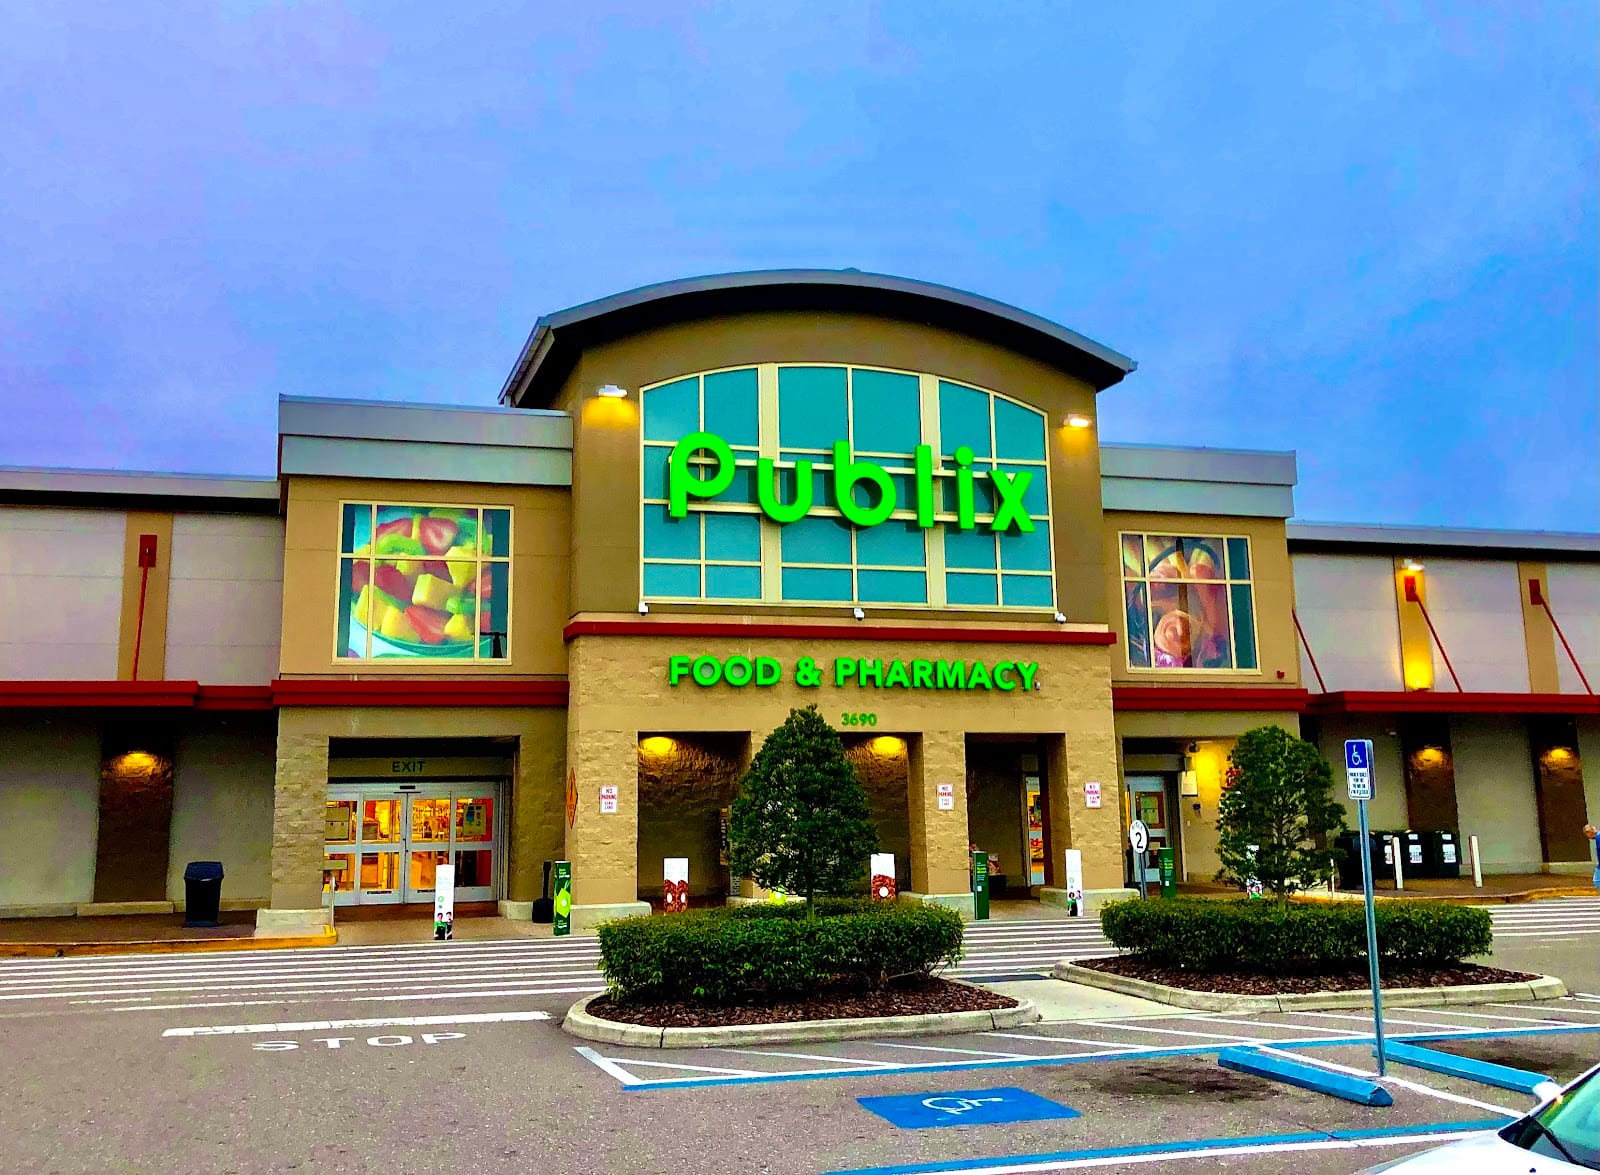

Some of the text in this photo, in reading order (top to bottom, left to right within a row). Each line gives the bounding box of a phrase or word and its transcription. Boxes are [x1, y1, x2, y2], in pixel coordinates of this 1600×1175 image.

[669, 432, 1036, 533] Publix
[669, 656, 1039, 691] FOOD & PHARMACY
[841, 713, 877, 727] 3690
[392, 760, 425, 773] EXIT
[1135, 832, 1144, 849] 2
[252, 1032, 467, 1051] STOP
